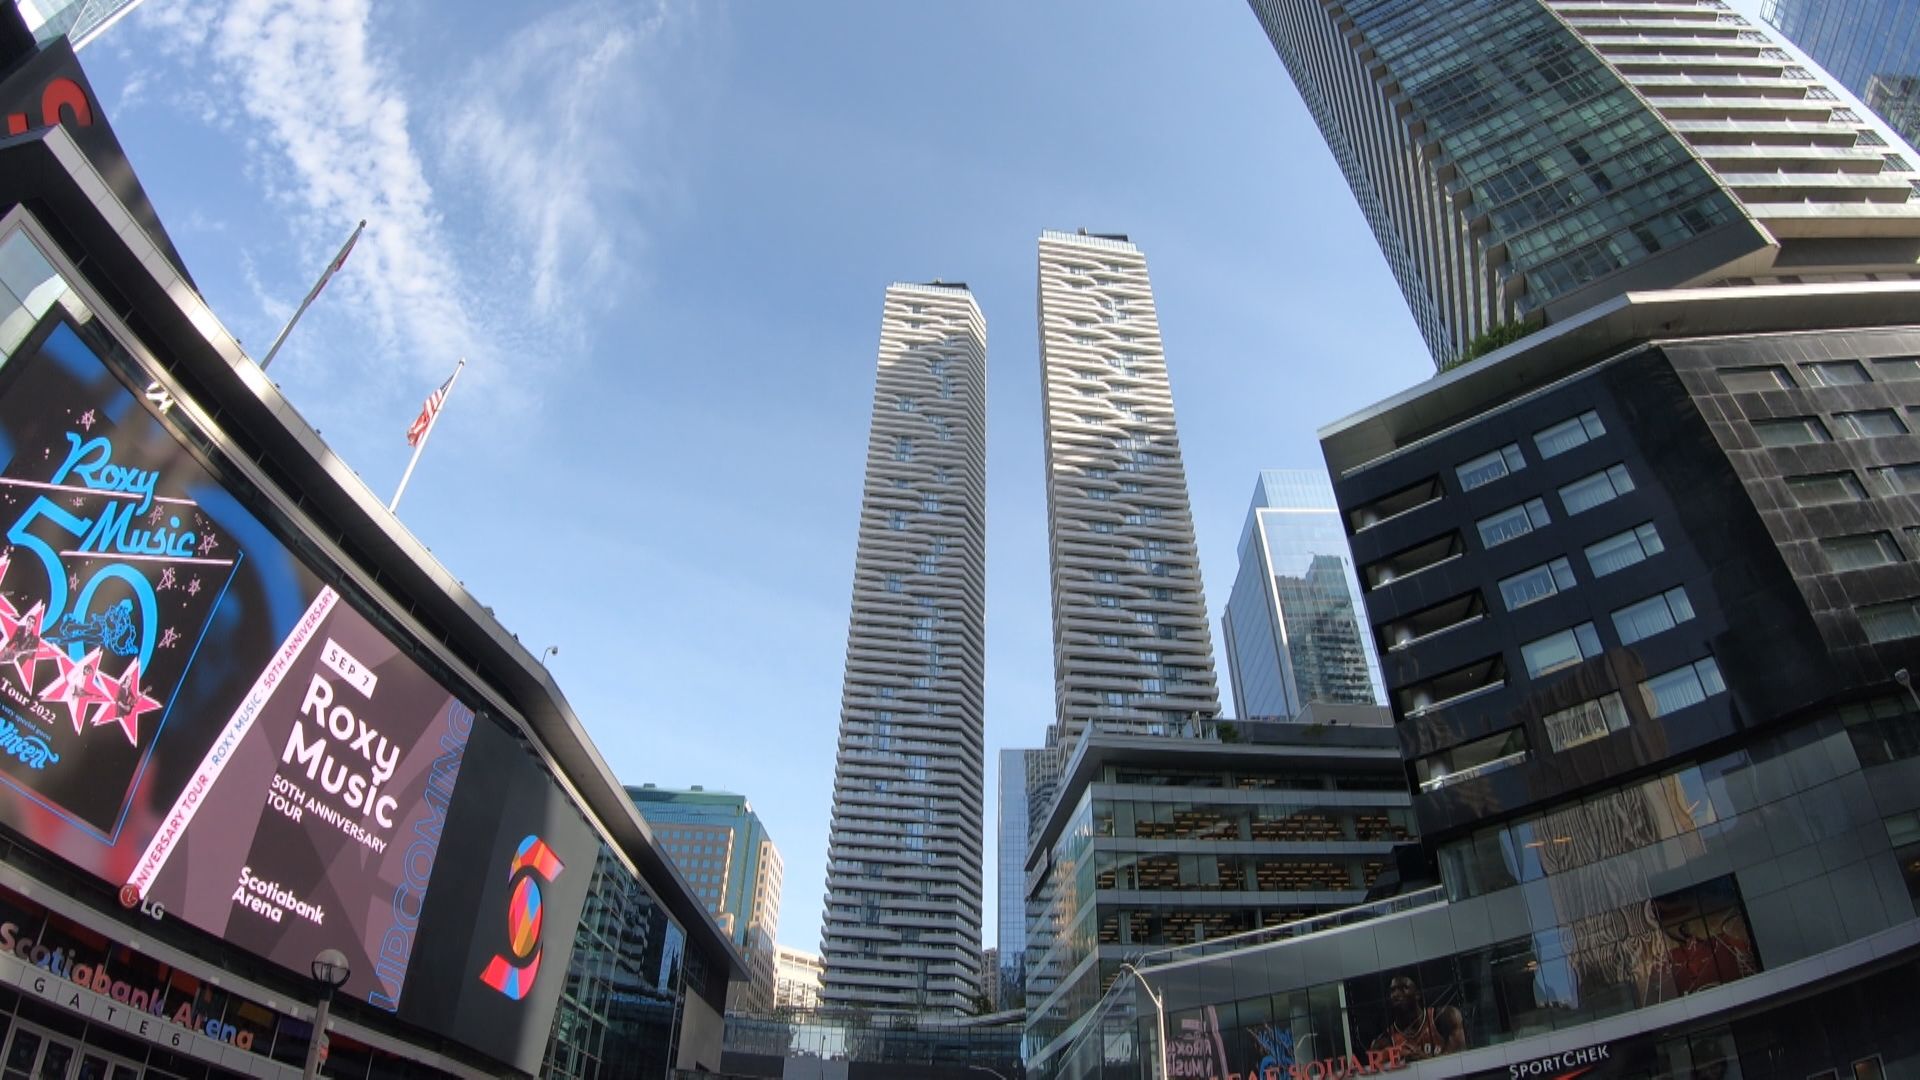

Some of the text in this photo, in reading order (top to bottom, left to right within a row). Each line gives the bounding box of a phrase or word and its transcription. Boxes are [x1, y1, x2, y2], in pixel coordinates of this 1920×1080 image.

[51, 431, 160, 516] Roxy
[79, 501, 196, 558] Music
[329, 649, 356, 677] SEP
[0, 677, 57, 725] Tour 2022
[182, 773, 209, 811] TOUR
[211, 725, 237, 766] ROXY
[235, 694, 262, 731] MUSIC
[263, 658, 286, 690] 50TH
[283, 590, 334, 662] ANNIVERSARY
[267, 789, 304, 824] TOUR
[271, 774, 388, 855] 50TH ANNIVERSARY
[140, 895, 165, 920] LG
[231, 886, 283, 923] Arena
[238, 867, 326, 926] Scotiabank
[0, 921, 254, 1052] Scotiabank Arena
[34, 976, 182, 1047] GATE 6
[1509, 1044, 1610, 1080] SPORTCHEK
